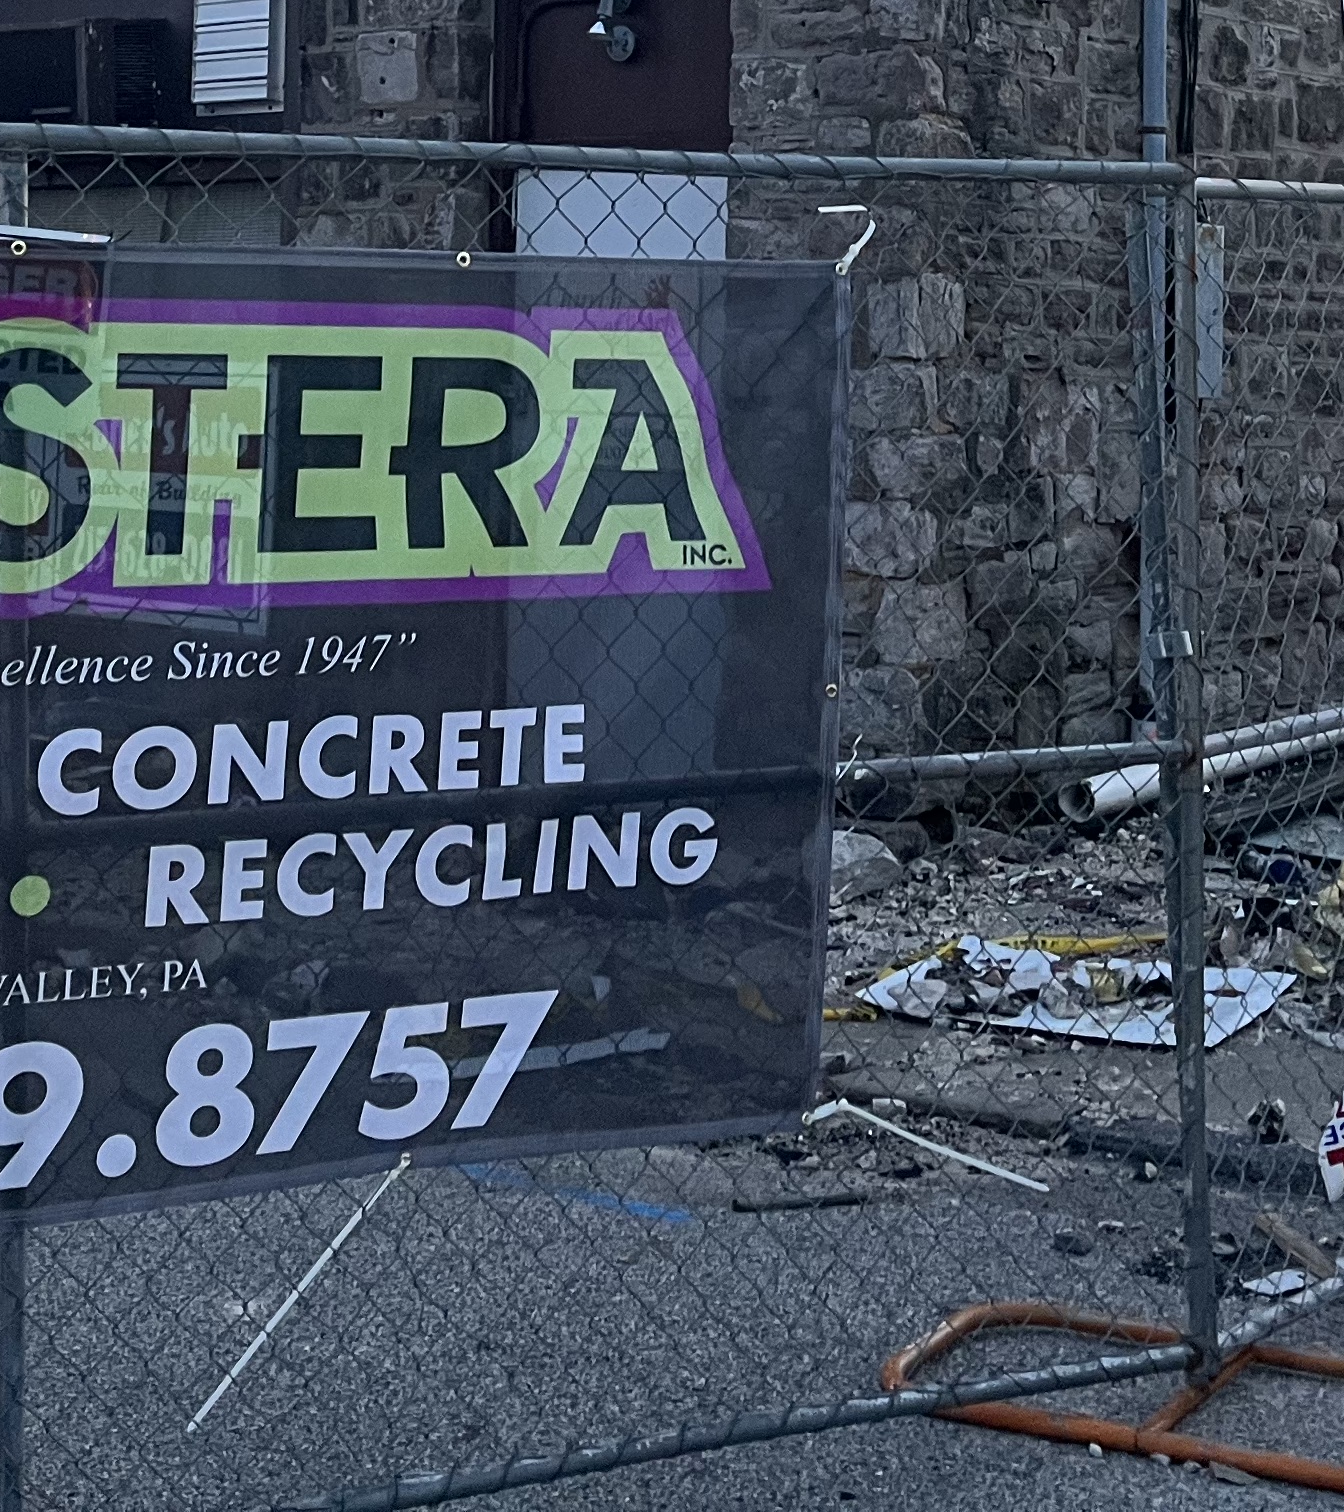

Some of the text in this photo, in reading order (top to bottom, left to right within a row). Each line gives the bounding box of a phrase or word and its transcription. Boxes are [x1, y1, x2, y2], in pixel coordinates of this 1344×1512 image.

[681, 543, 733, 567] INC.
[167, 640, 282, 681] Since
[37, 703, 586, 817] CONCRETE
[144, 807, 719, 928] RECYCLING
[162, 958, 208, 992] PA
